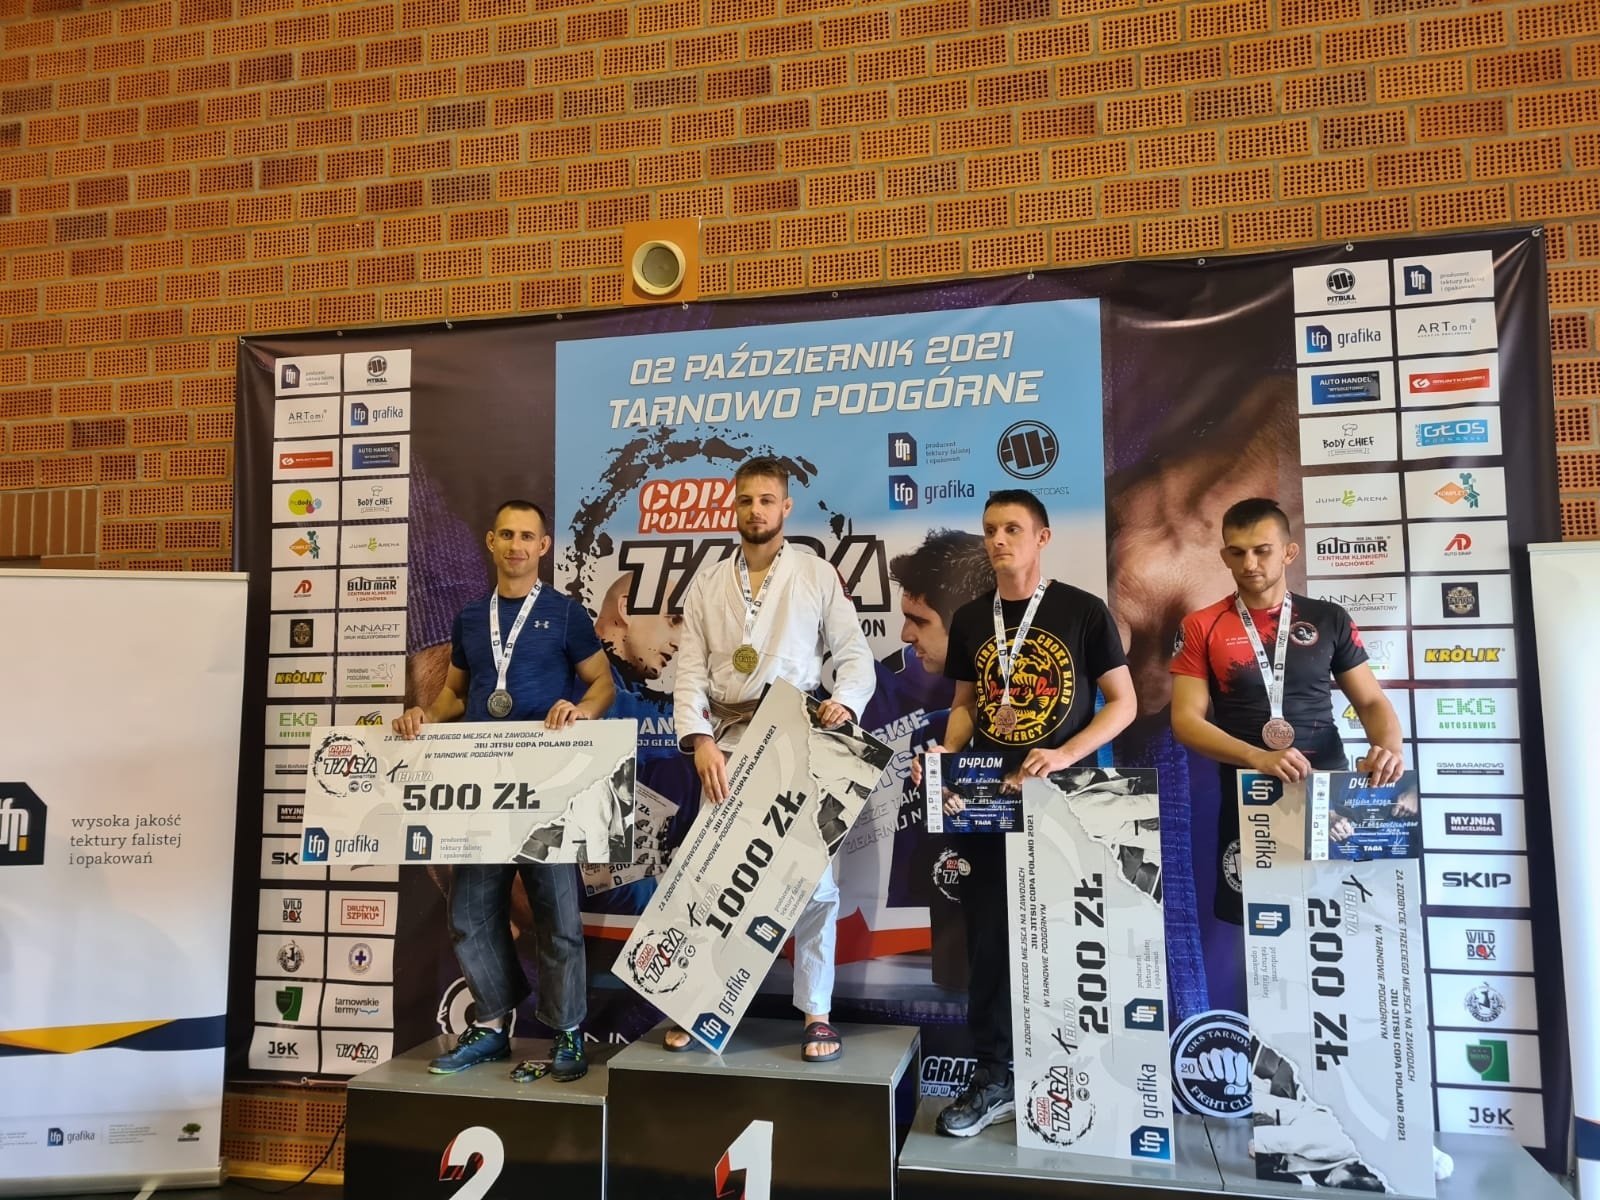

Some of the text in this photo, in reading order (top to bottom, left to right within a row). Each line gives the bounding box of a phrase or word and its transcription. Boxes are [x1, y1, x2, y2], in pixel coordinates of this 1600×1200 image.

[1312, 328, 1381, 350] tfp grafika
[630, 330, 1016, 386] 02 PAŹDZIERNIK 2021
[609, 366, 1044, 429] TARNOWO PODGÓRNE
[354, 406, 403, 423] tfp grafika
[1348, 436, 1374, 447] CHIEF
[894, 480, 974, 505] tfp grafika
[642, 512, 739, 530] POLAN
[344, 624, 400, 632] ANNART
[1425, 645, 1500, 662] KRÓLIK
[275, 670, 325, 684] KRÓLIK
[1037, 634, 1072, 704] CHOKE HARD
[1036, 676, 1058, 696] Den
[1437, 698, 1496, 716] EKG
[280, 712, 318, 726] EKG
[721, 796, 736, 819] JITSU
[734, 776, 748, 796] COPA
[745, 744, 766, 776] POLAND
[762, 725, 776, 745] 2021
[959, 758, 1003, 768] DYPLOM
[402, 782, 540, 811] 500 ZŁ
[72, 814, 182, 830] wysoka jakość
[1248, 780, 1276, 869] tfp grafika
[1451, 816, 1495, 826] MYJNIA
[70, 832, 182, 850] tektury falistej
[308, 834, 379, 858] tfp grafika
[681, 828, 706, 871] PIERWSZEGO
[76, 852, 153, 868] opakowań
[272, 852, 298, 864] SK
[700, 841, 720, 875] TARNOWIE
[706, 838, 774, 939] 1000
[762, 791, 807, 838] ZŁ
[1396, 870, 1404, 880] ZA
[1442, 872, 1511, 888] SKIP
[283, 900, 302, 910] WILD
[282, 910, 302, 922] BOX
[1020, 914, 1026, 924] NA
[1466, 931, 1495, 944] WILD
[1074, 874, 1109, 1034] 200 ZŁ
[1376, 936, 1385, 982] TARNOWIE
[1400, 928, 1410, 974] TRZECIEGO
[1467, 944, 1496, 958] BOX
[1308, 898, 1349, 1071] 200 ZŁ
[336, 998, 380, 1007] tarnowskie
[700, 968, 751, 1040] tfp grafika
[1402, 976, 1412, 1014] MIEJSCA
[334, 1006, 358, 1016] termy
[1404, 1018, 1412, 1030] NA
[268, 1041, 298, 1056] J&K
[1025, 1046, 1032, 1058] ZA
[1187, 1034, 1206, 1053] GKS
[1390, 989, 1406, 1141] JIU JITSU COPA POLAND 2021
[1406, 1031, 1415, 1082] ZAWODACH
[1180, 1063, 1196, 1074] 20
[1190, 1086, 1228, 1110] FIGHT
[1138, 1064, 1164, 1153] tfp grafika
[1468, 1107, 1514, 1126] J&K
[50, 1131, 62, 1144] tfp
[66, 1130, 95, 1144] grafika
[440, 1126, 505, 1200] 2
[715, 1119, 773, 1200] 1
